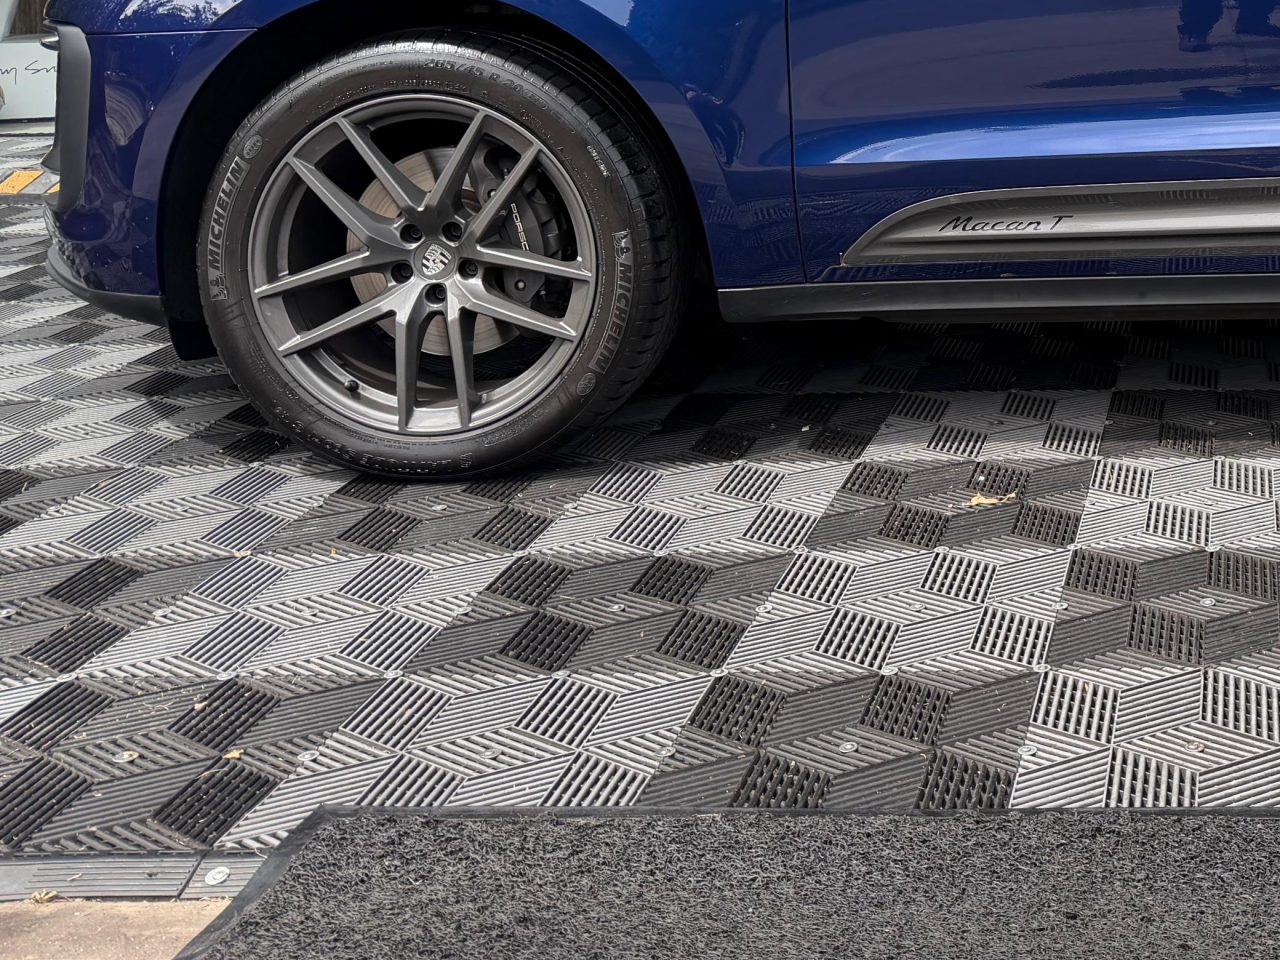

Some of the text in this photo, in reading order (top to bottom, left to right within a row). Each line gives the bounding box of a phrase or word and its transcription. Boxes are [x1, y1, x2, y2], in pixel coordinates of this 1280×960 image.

[208, 159, 246, 271] MICHELIN
[510, 203, 530, 252] PORSC
[938, 215, 1074, 232] Macan T
[595, 262, 633, 373] MICHELIN
